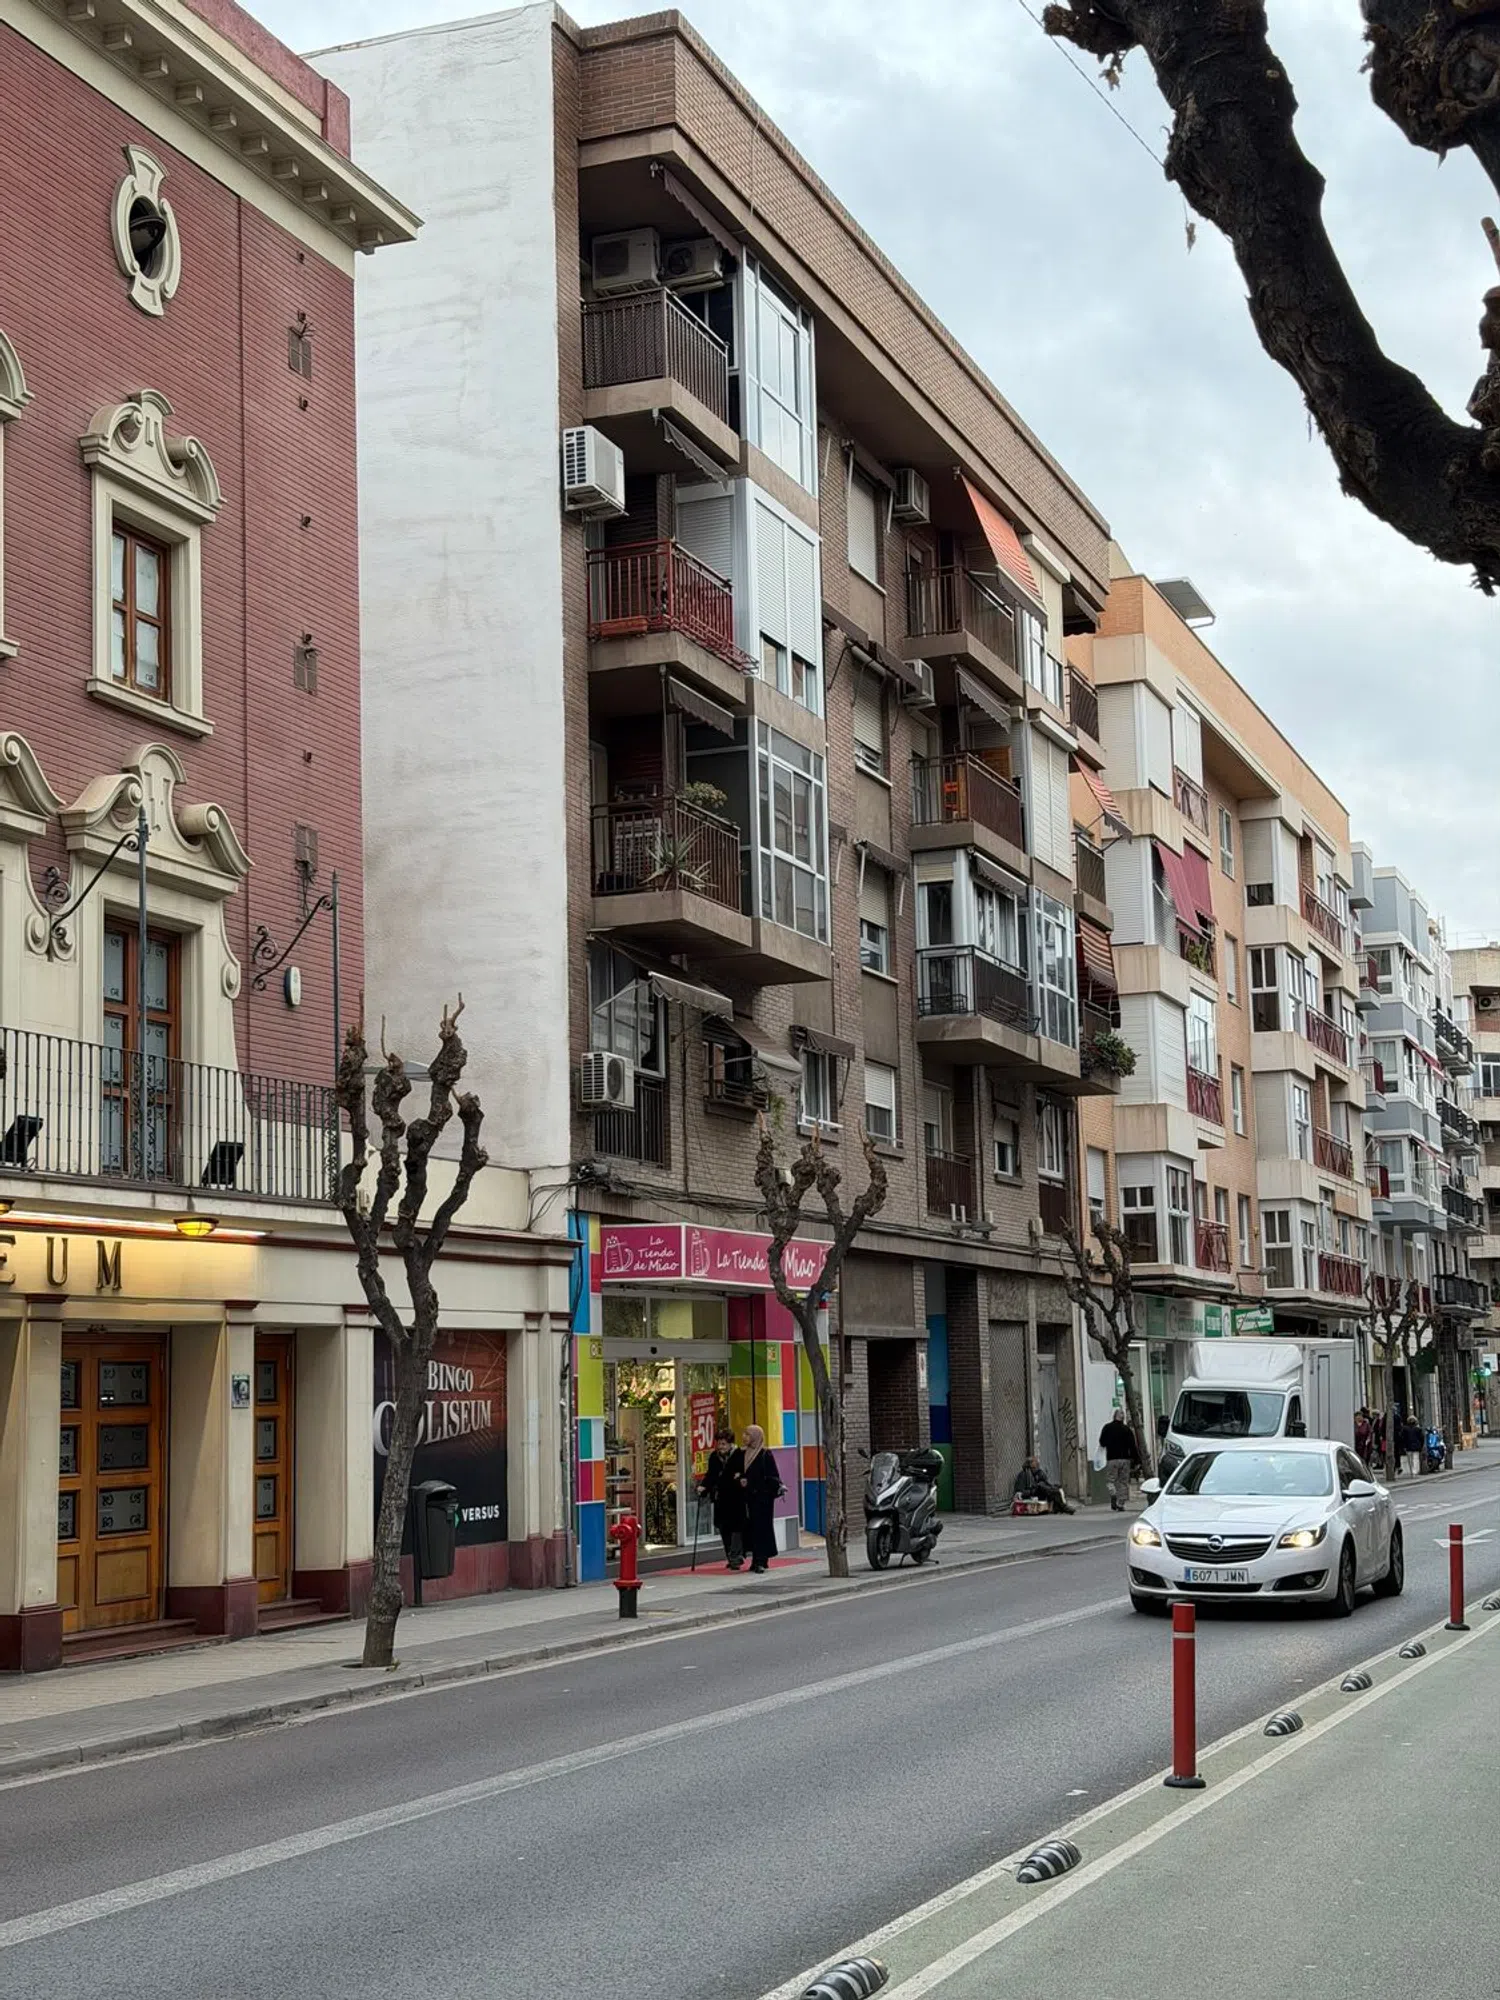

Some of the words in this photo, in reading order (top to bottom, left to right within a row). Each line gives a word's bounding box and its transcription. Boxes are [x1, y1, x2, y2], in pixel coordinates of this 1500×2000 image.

[649, 1235, 664, 1246] La
[638, 1247, 676, 1259] Tienda
[633, 1260, 647, 1271] de
[648, 1258, 679, 1272] Miao
[716, 1248, 731, 1269] La
[732, 1249, 767, 1272] Tienda
[784, 1247, 816, 1279] Miao
[427, 1360, 475, 1393] BINGO
[461, 1504, 500, 1522] VERSUS
[1192, 1570, 1219, 1582] 6071
[1223, 1570, 1245, 1583] JMN
